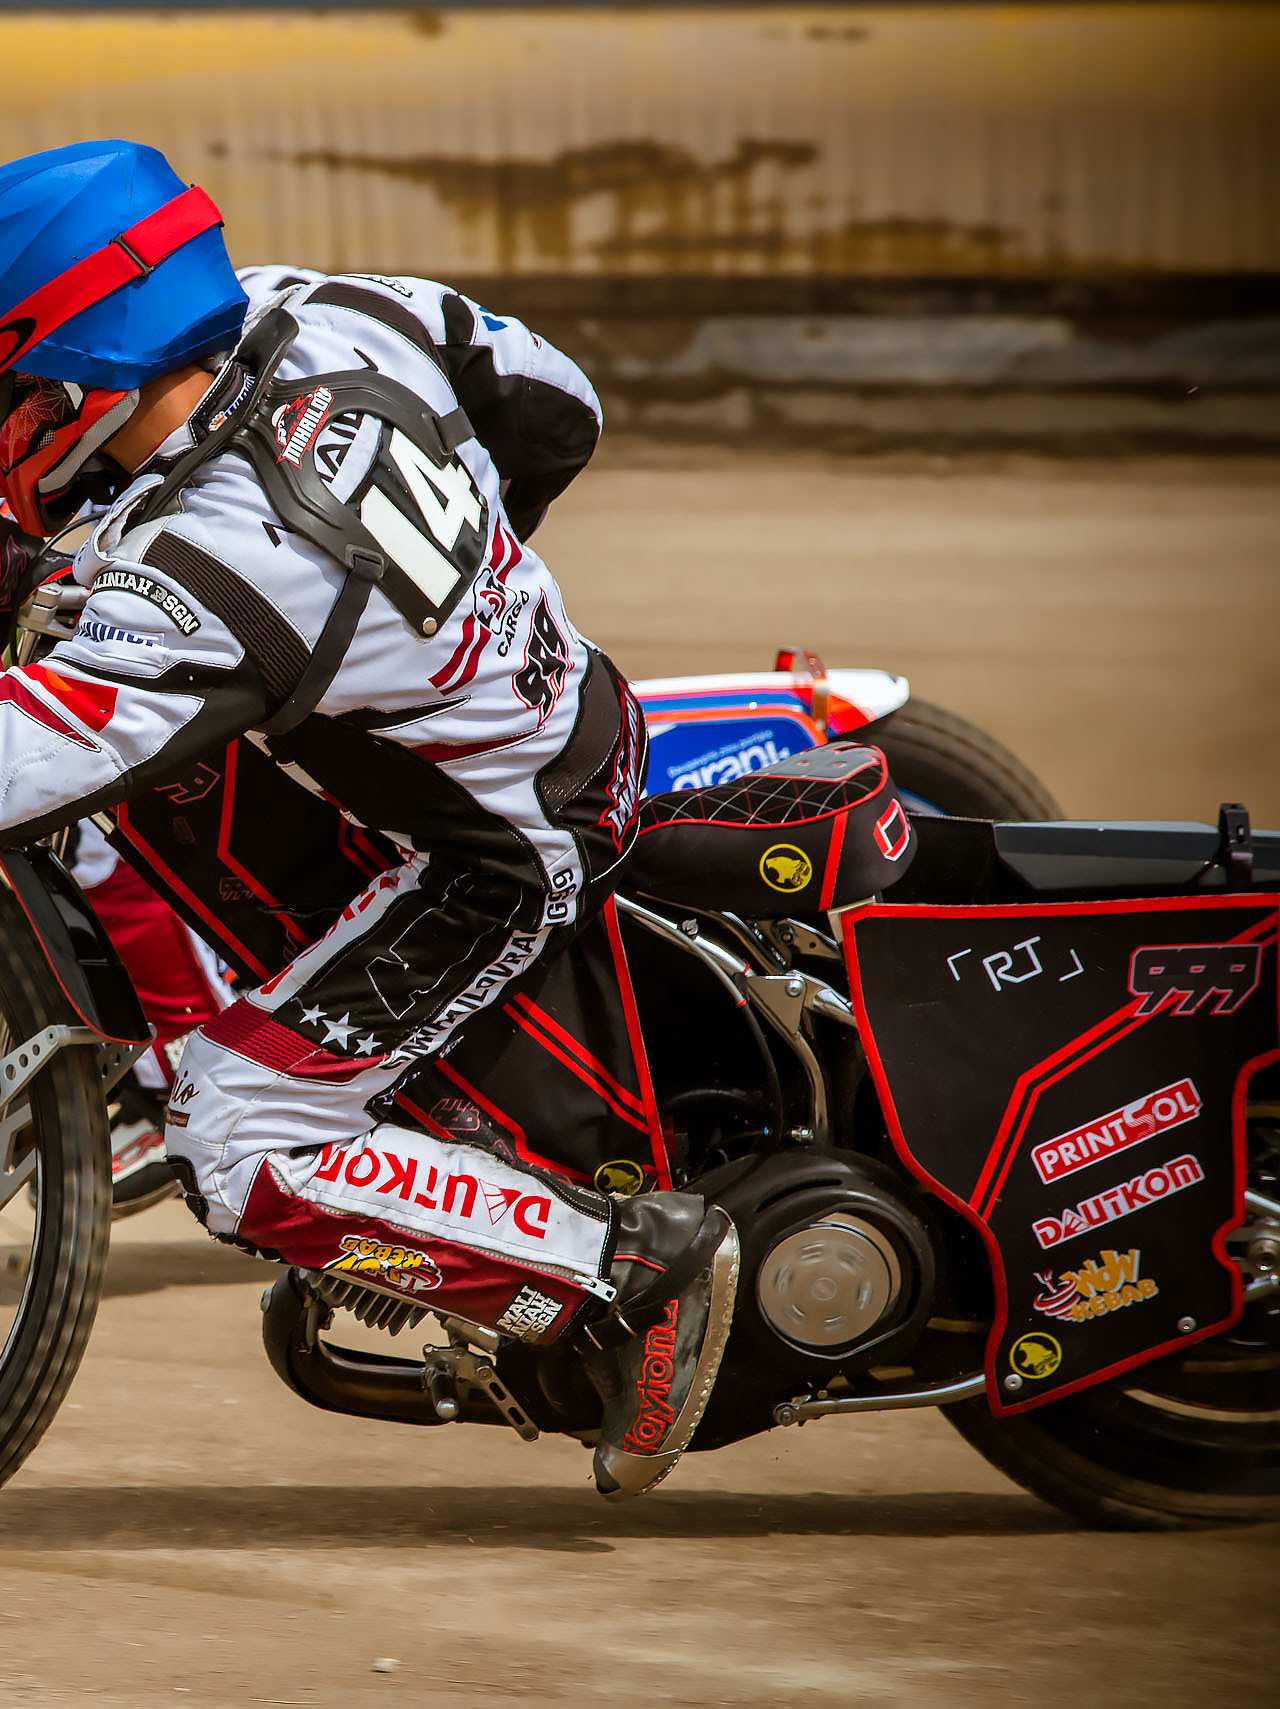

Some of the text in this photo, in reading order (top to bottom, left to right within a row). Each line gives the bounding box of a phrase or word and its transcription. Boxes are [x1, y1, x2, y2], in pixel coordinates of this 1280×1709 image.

[282, 386, 332, 465] MIHAILOV
[361, 427, 482, 609] 14
[497, 589, 530, 657] CARGO
[1038, 1090, 1196, 1175] PRINTSOL
[1034, 1155, 1203, 1248] DAUTKOM
[341, 1238, 423, 1269] KEBAB
[1059, 1248, 1141, 1299] WOW
[496, 1285, 538, 1331] MALI
[1070, 1278, 1160, 1323] KEBAB
